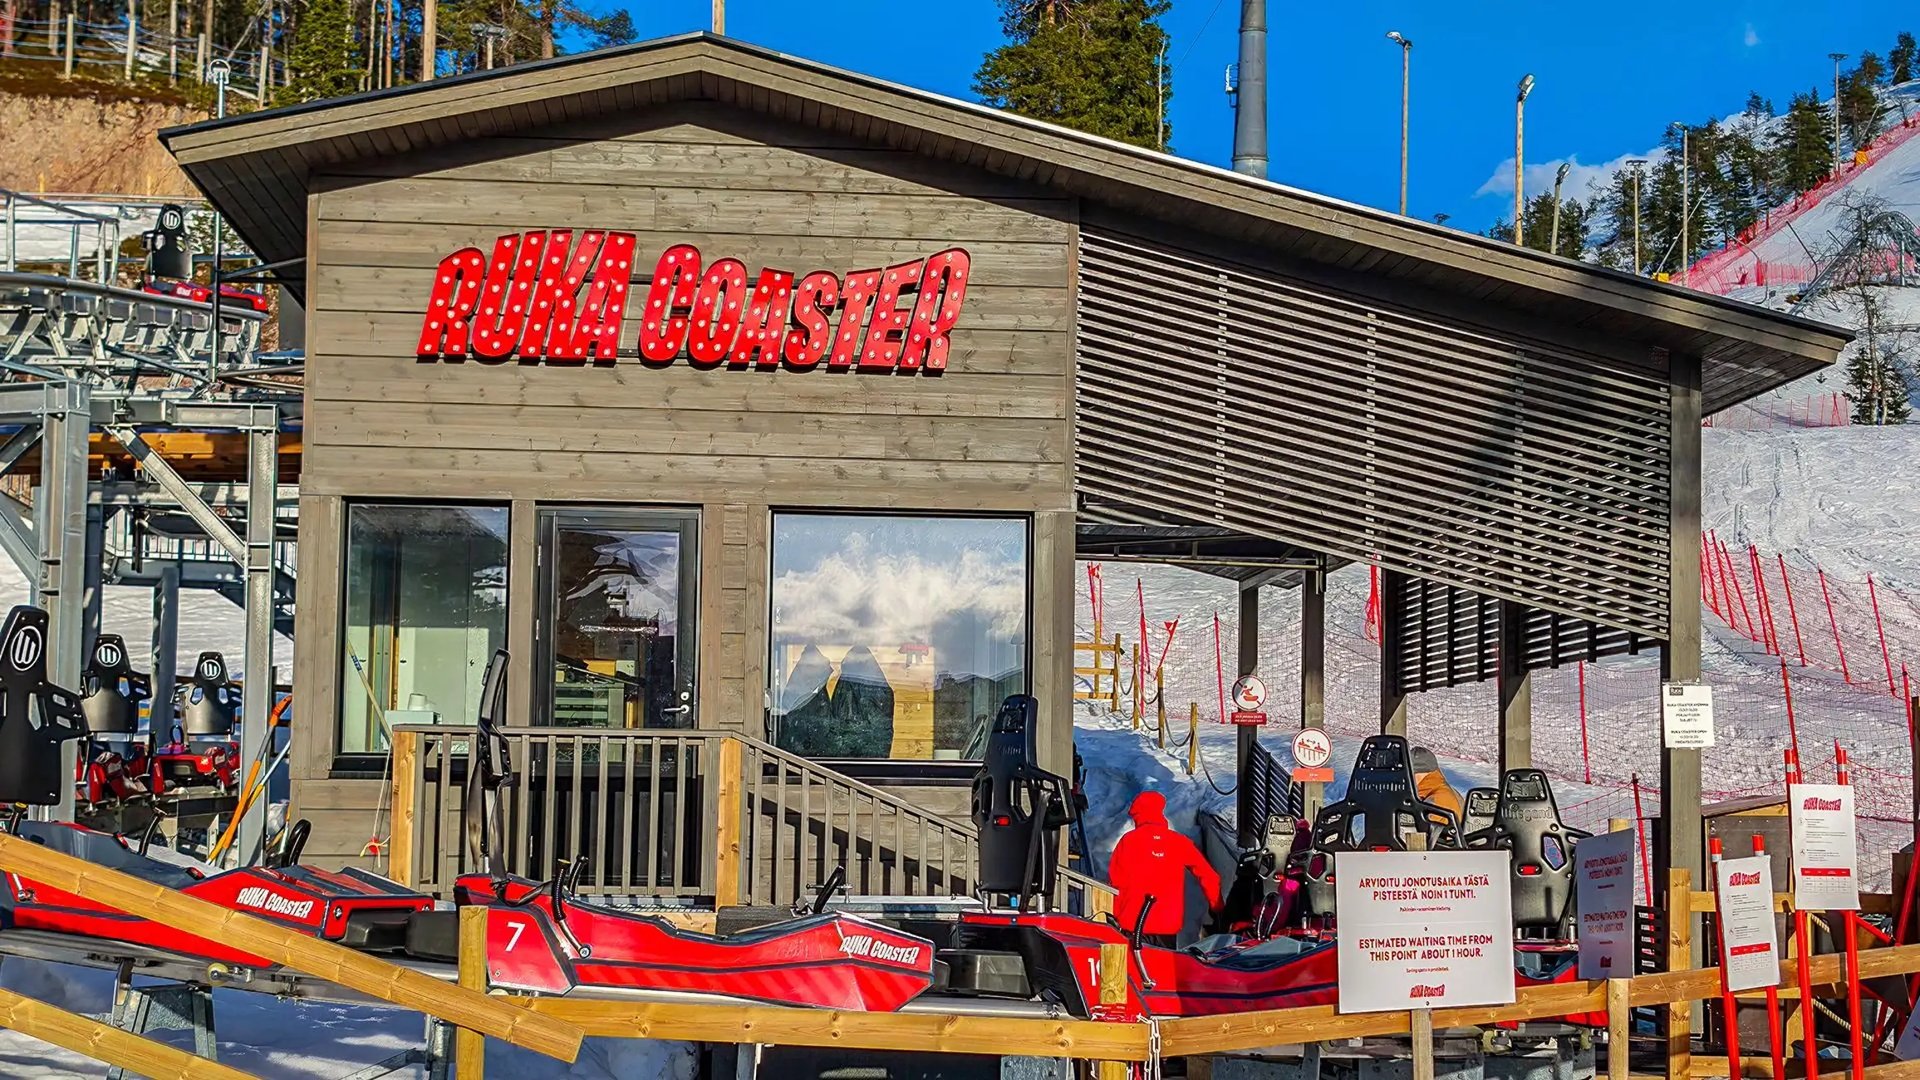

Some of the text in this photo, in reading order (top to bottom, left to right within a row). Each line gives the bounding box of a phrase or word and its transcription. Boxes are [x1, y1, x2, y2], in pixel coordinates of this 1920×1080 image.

[417, 230, 972, 374] RUKA COASTER
[1359, 874, 1489, 888] ARVIOITU JONOTUSAIKA TÄSTÄ
[236, 887, 314, 918] RUKA COASTER
[1373, 888, 1476, 900] PISTEESTÄ NOIN 1 TUNTI.
[505, 921, 526, 952] 7
[1359, 934, 1492, 949] ESTIMATED WAITING TIME FROM
[839, 935, 920, 965] RUKA COASTER
[1370, 948, 1483, 961] THIS POINT ABOUT 1 HOUR.
